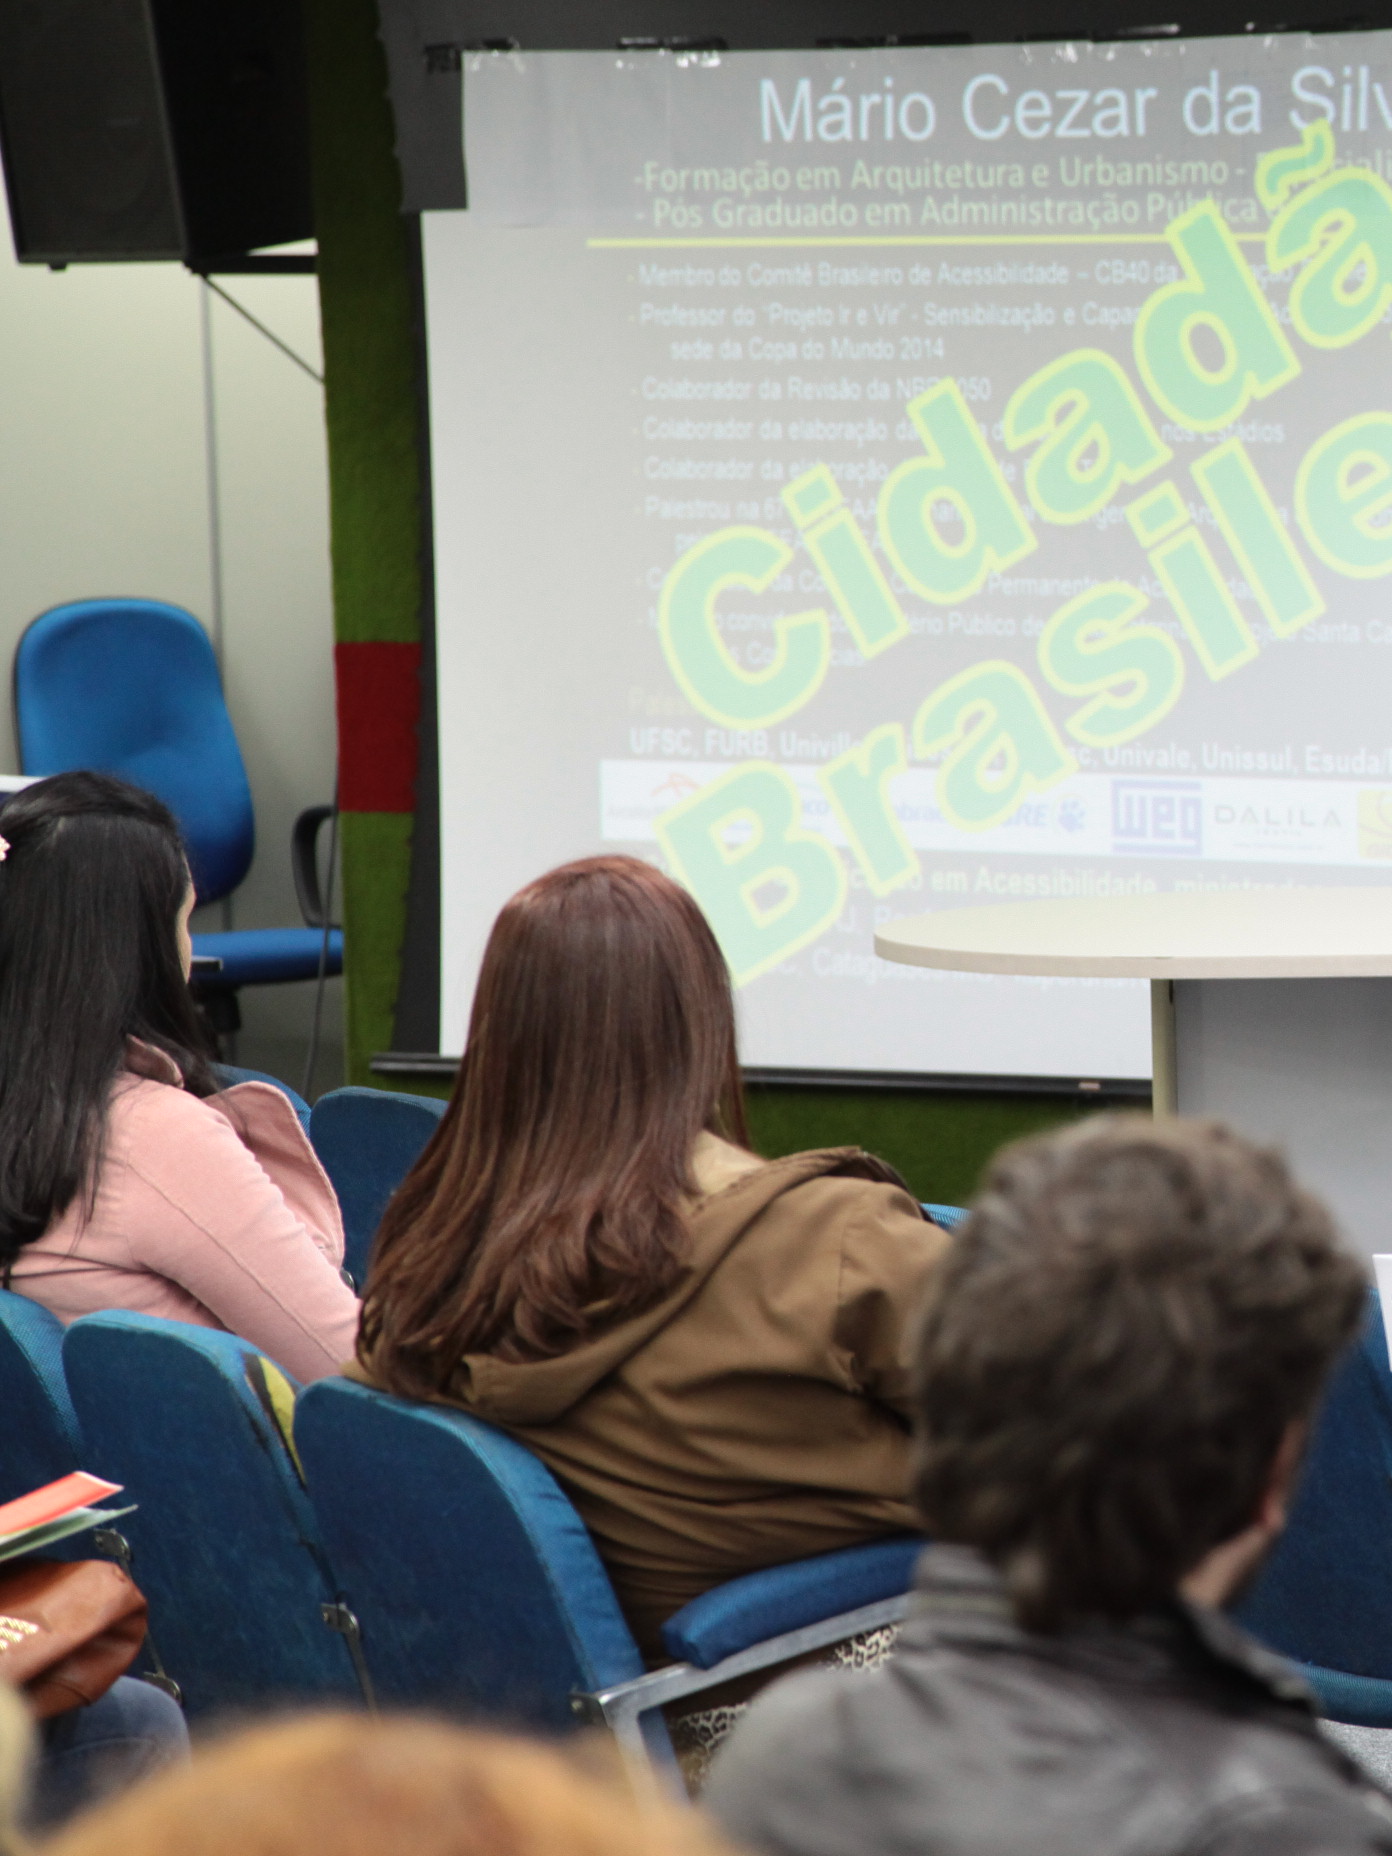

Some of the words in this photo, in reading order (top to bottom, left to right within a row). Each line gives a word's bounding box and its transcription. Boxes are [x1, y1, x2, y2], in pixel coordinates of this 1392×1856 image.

[759, 76, 937, 142] Mário
[962, 72, 1158, 138] Cezar
[1183, 68, 1261, 134] da
[796, 166, 840, 190] em
[851, 157, 1025, 195] Arquitetura
[1031, 163, 1049, 188] e
[1059, 156, 1228, 188] Urbanismo
[653, 197, 703, 229] Pós
[711, 196, 858, 229] Graduado
[864, 199, 912, 226] em
[920, 189, 1140, 231] Administração
[638, 264, 714, 287] Membro
[718, 264, 741, 286] do
[817, 261, 902, 286] Brasileiro
[908, 260, 931, 285] de
[937, 259, 1069, 286] Acessibilidade
[1093, 258, 1151, 285] CB40
[639, 302, 725, 327] Professor
[731, 302, 755, 326] do
[924, 300, 1056, 333] Sensibilização
[669, 337, 713, 362] sede
[719, 337, 742, 361] da
[749, 337, 794, 366] Copa
[800, 337, 824, 361] do
[831, 337, 895, 361] Mundo
[901, 336, 945, 360] 2014
[641, 376, 752, 402] Colaborador
[758, 376, 782, 401] da
[788, 375, 859, 401] Revisão
[866, 376, 890, 401] da
[643, 415, 753, 441] Colaborador
[759, 416, 783, 441] da
[788, 416, 888, 449] elaboração
[644, 455, 754, 480] Colaborador
[760, 456, 784, 480] da
[629, 726, 699, 758] UFSC,
[704, 728, 776, 762] FURB,
[1214, 804, 1342, 829] DALILA
